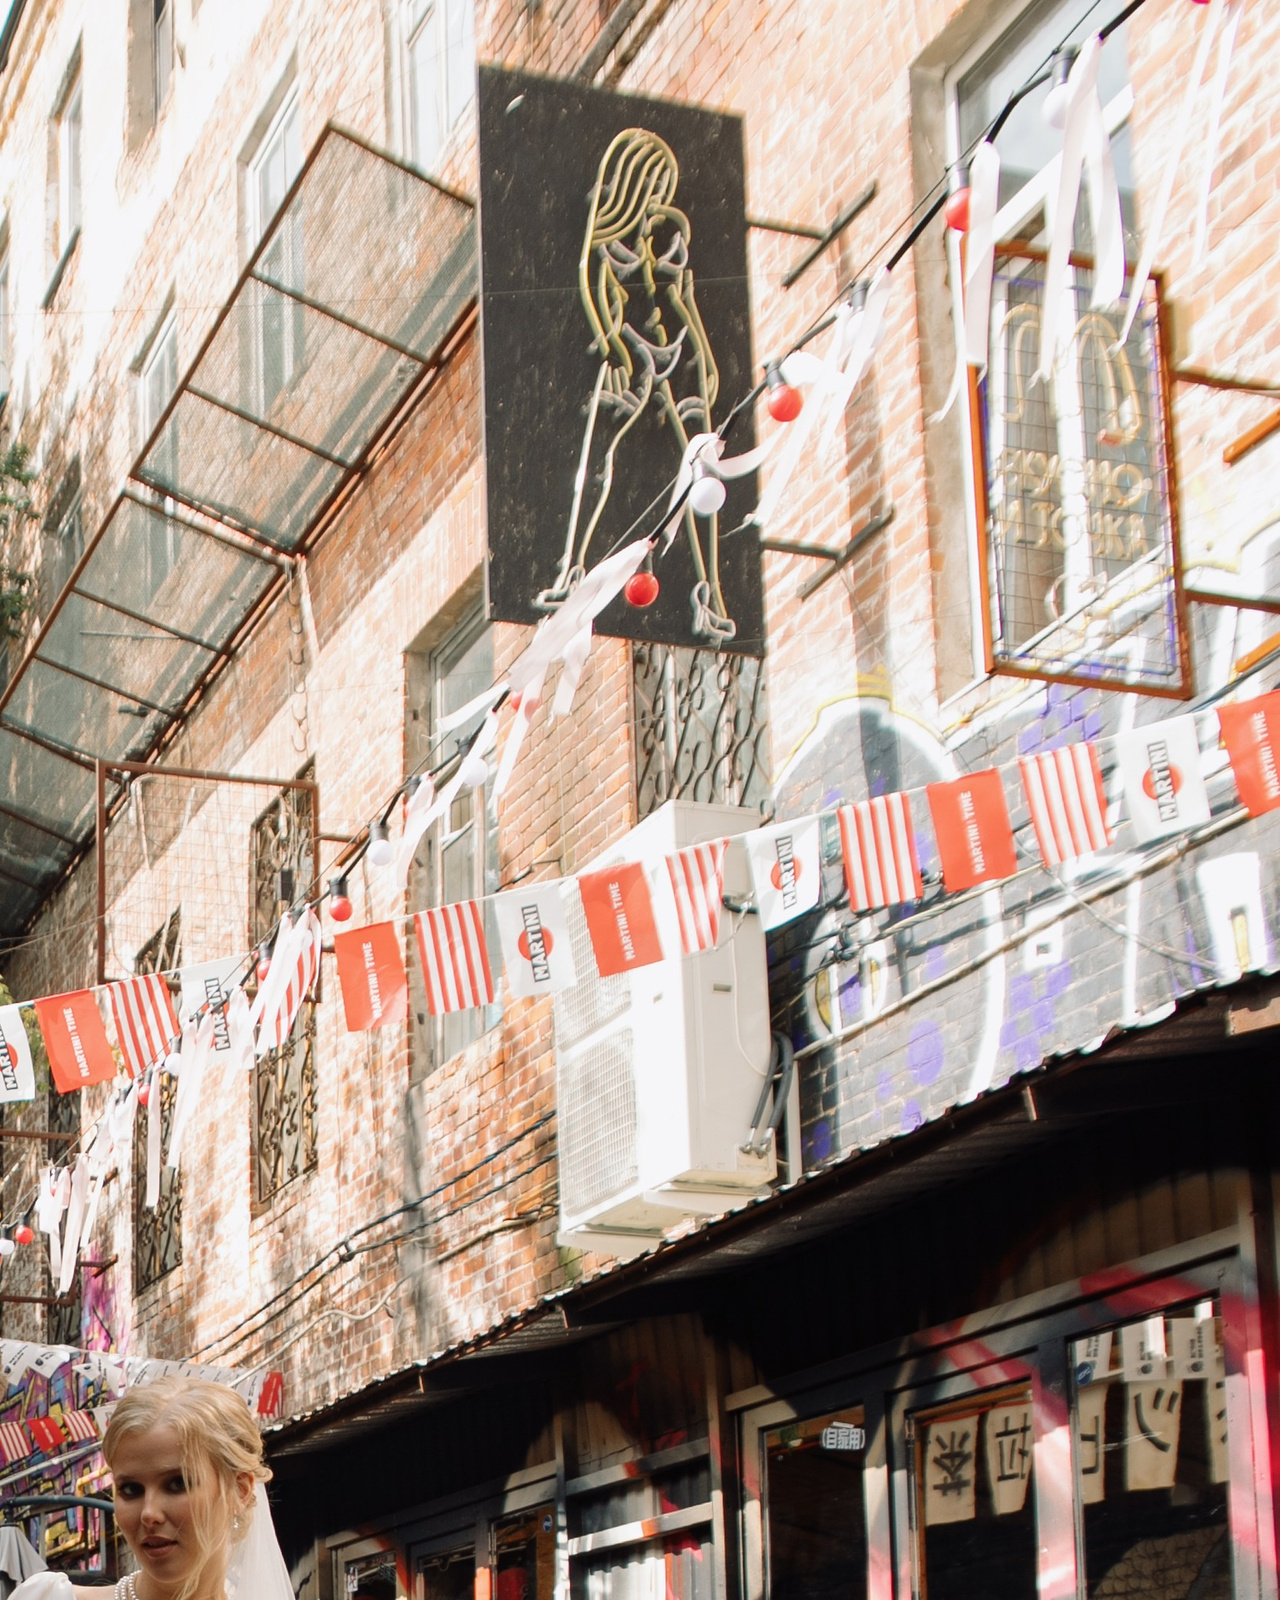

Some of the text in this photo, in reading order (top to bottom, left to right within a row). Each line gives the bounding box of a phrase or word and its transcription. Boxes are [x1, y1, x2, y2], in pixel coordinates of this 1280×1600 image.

[1252, 709, 1269, 742] TIME
[1147, 739, 1179, 822] MARTINI
[959, 790, 986, 875] MARTINI TIME
[775, 834, 797, 910] MARTINI
[521, 903, 551, 983] MARTINI
[607, 881, 637, 960] MARTINI TIME
[361, 941, 382, 1018] MARTINI TIME
[63, 1007, 90, 1078] MARTINI TIME
